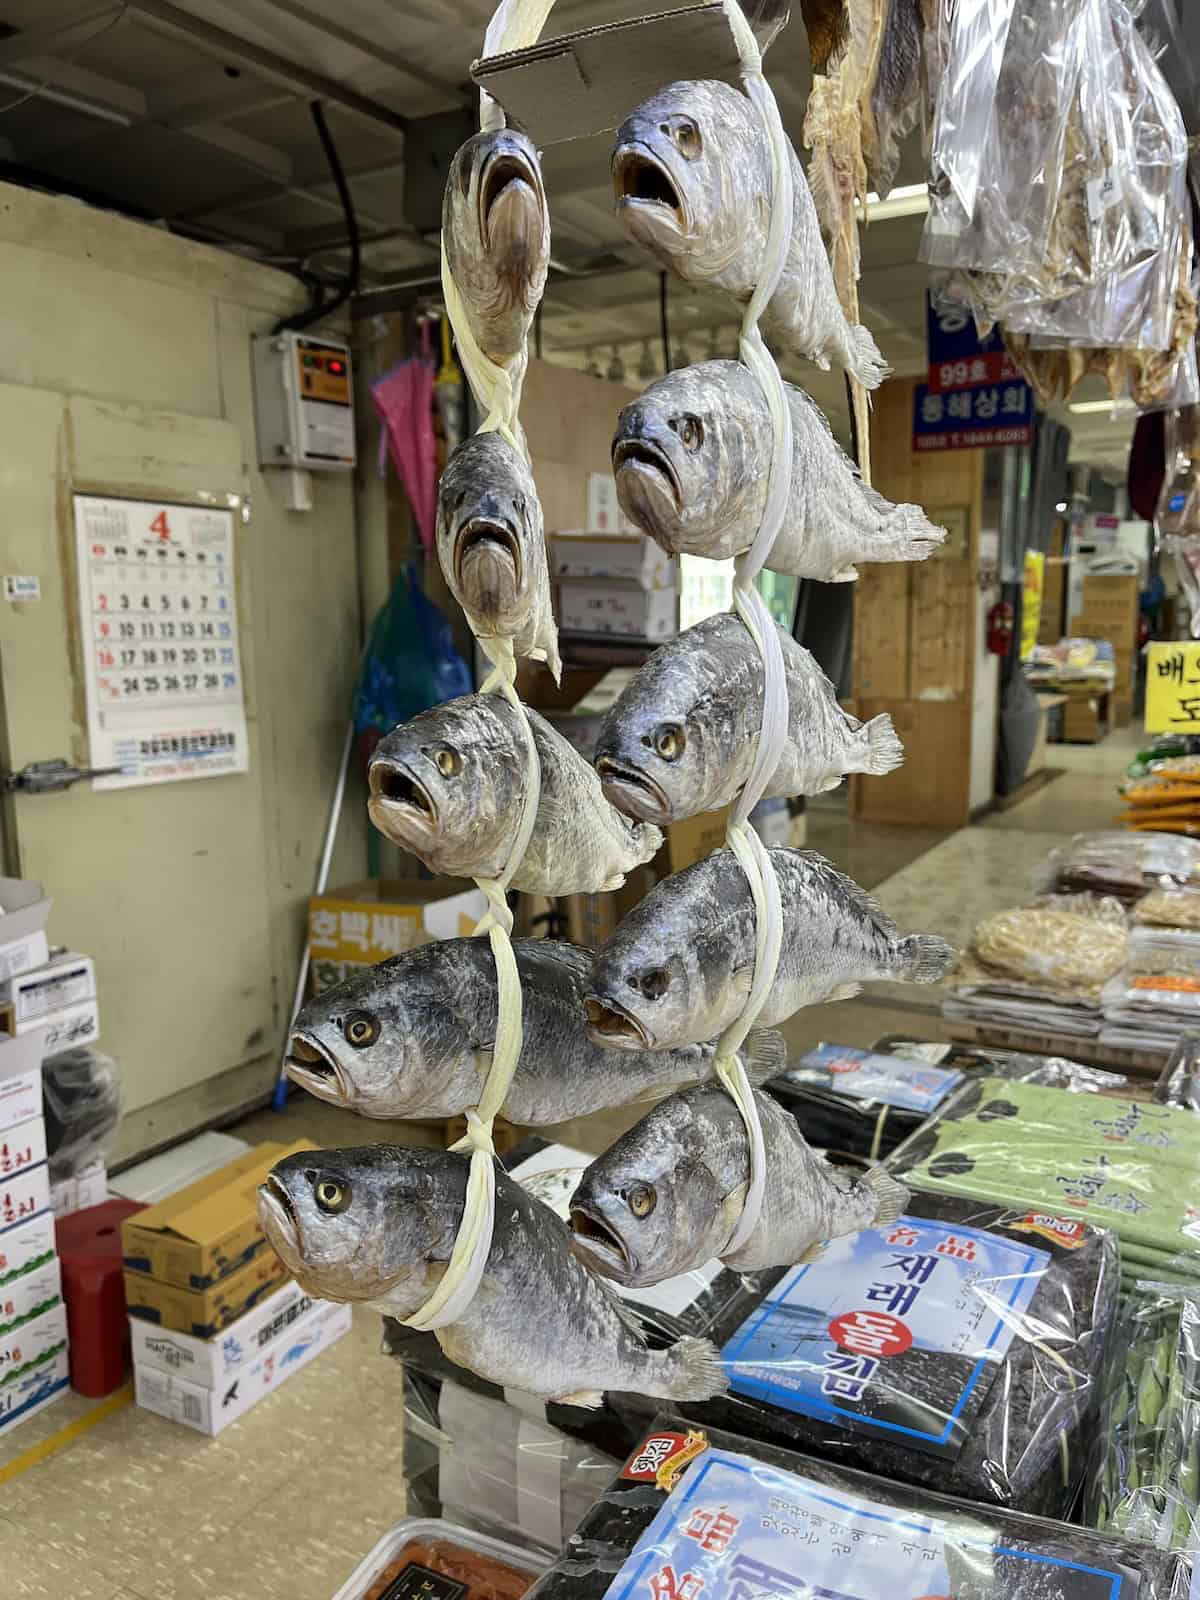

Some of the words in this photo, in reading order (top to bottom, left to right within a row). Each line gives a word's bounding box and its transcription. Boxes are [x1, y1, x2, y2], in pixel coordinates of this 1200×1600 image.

[921, 386, 1027, 424] 동해상회
[149, 511, 171, 540] 4
[98, 594, 107, 609] 2
[120, 594, 129, 609] 3
[142, 595, 149, 609] 4
[161, 594, 170, 609] 5
[182, 595, 190, 609] 6
[201, 595, 208, 609] 7
[120, 622, 135, 637] 10
[141, 622, 154, 637] 11
[161, 622, 175, 637] 12
[181, 622, 194, 637] 13
[200, 622, 213, 637] 14
[120, 649, 135, 664] 17
[142, 649, 156, 664] 18
[162, 649, 176, 663] 19
[182, 648, 197, 662] 20
[201, 648, 216, 662] 21
[122, 677, 138, 693] 24
[143, 676, 160, 691] 25
[164, 675, 179, 690] 26
[183, 674, 198, 689] 27
[203, 674, 218, 688] 28
